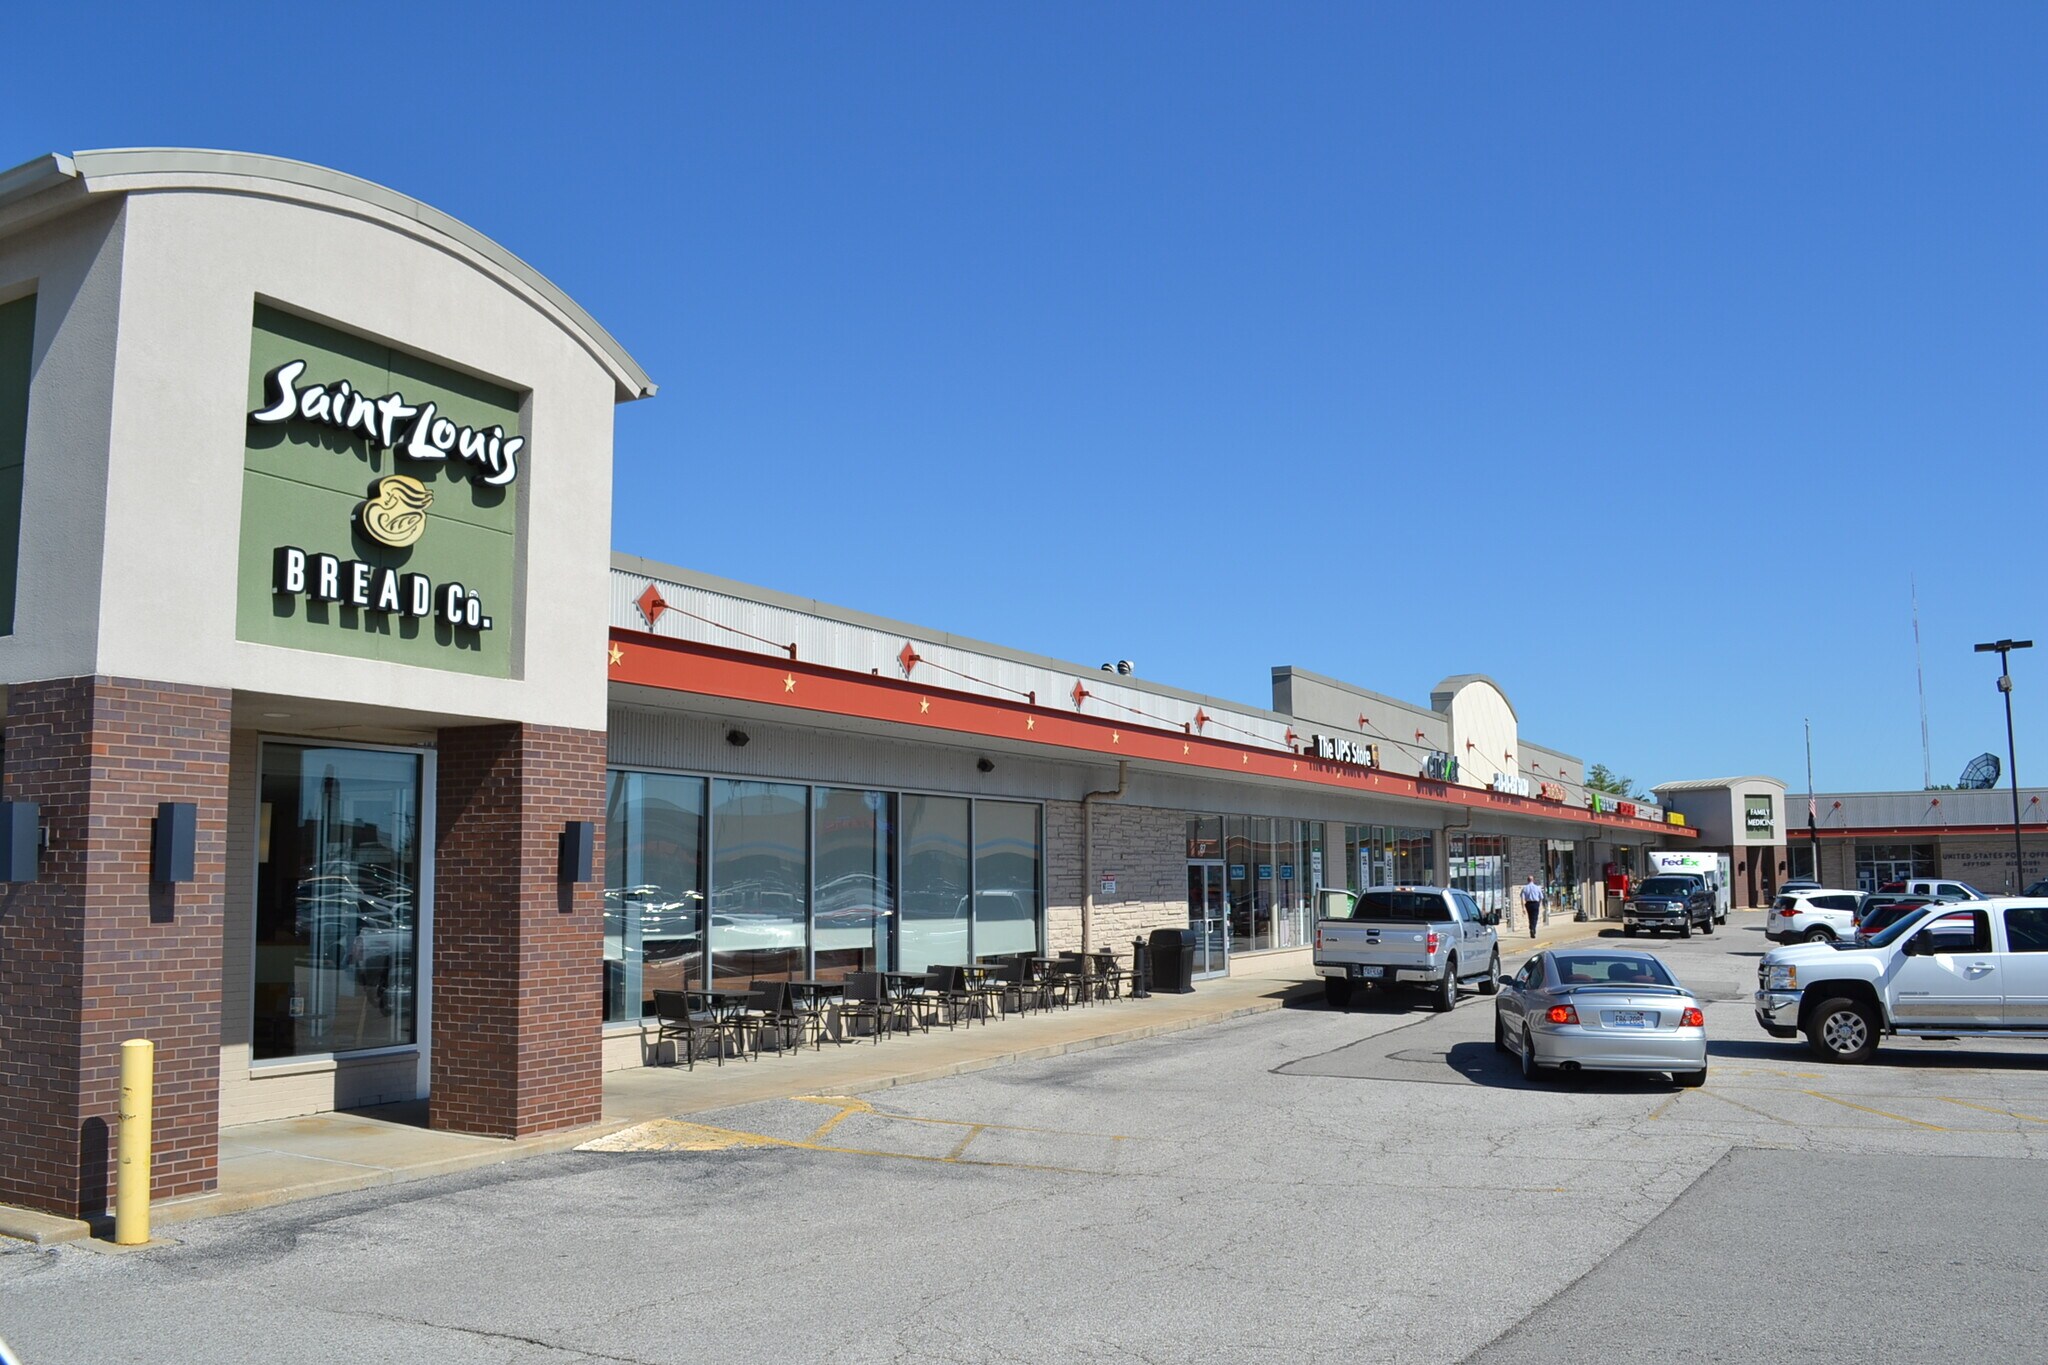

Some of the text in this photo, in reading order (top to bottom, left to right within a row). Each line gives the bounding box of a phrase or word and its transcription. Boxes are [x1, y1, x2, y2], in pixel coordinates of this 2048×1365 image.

[252, 360, 525, 485] Saint Louis
[285, 547, 491, 626] BREAD Co.
[1318, 735, 1371, 767] The UPS Store
[1661, 858, 1699, 866] FedEx
